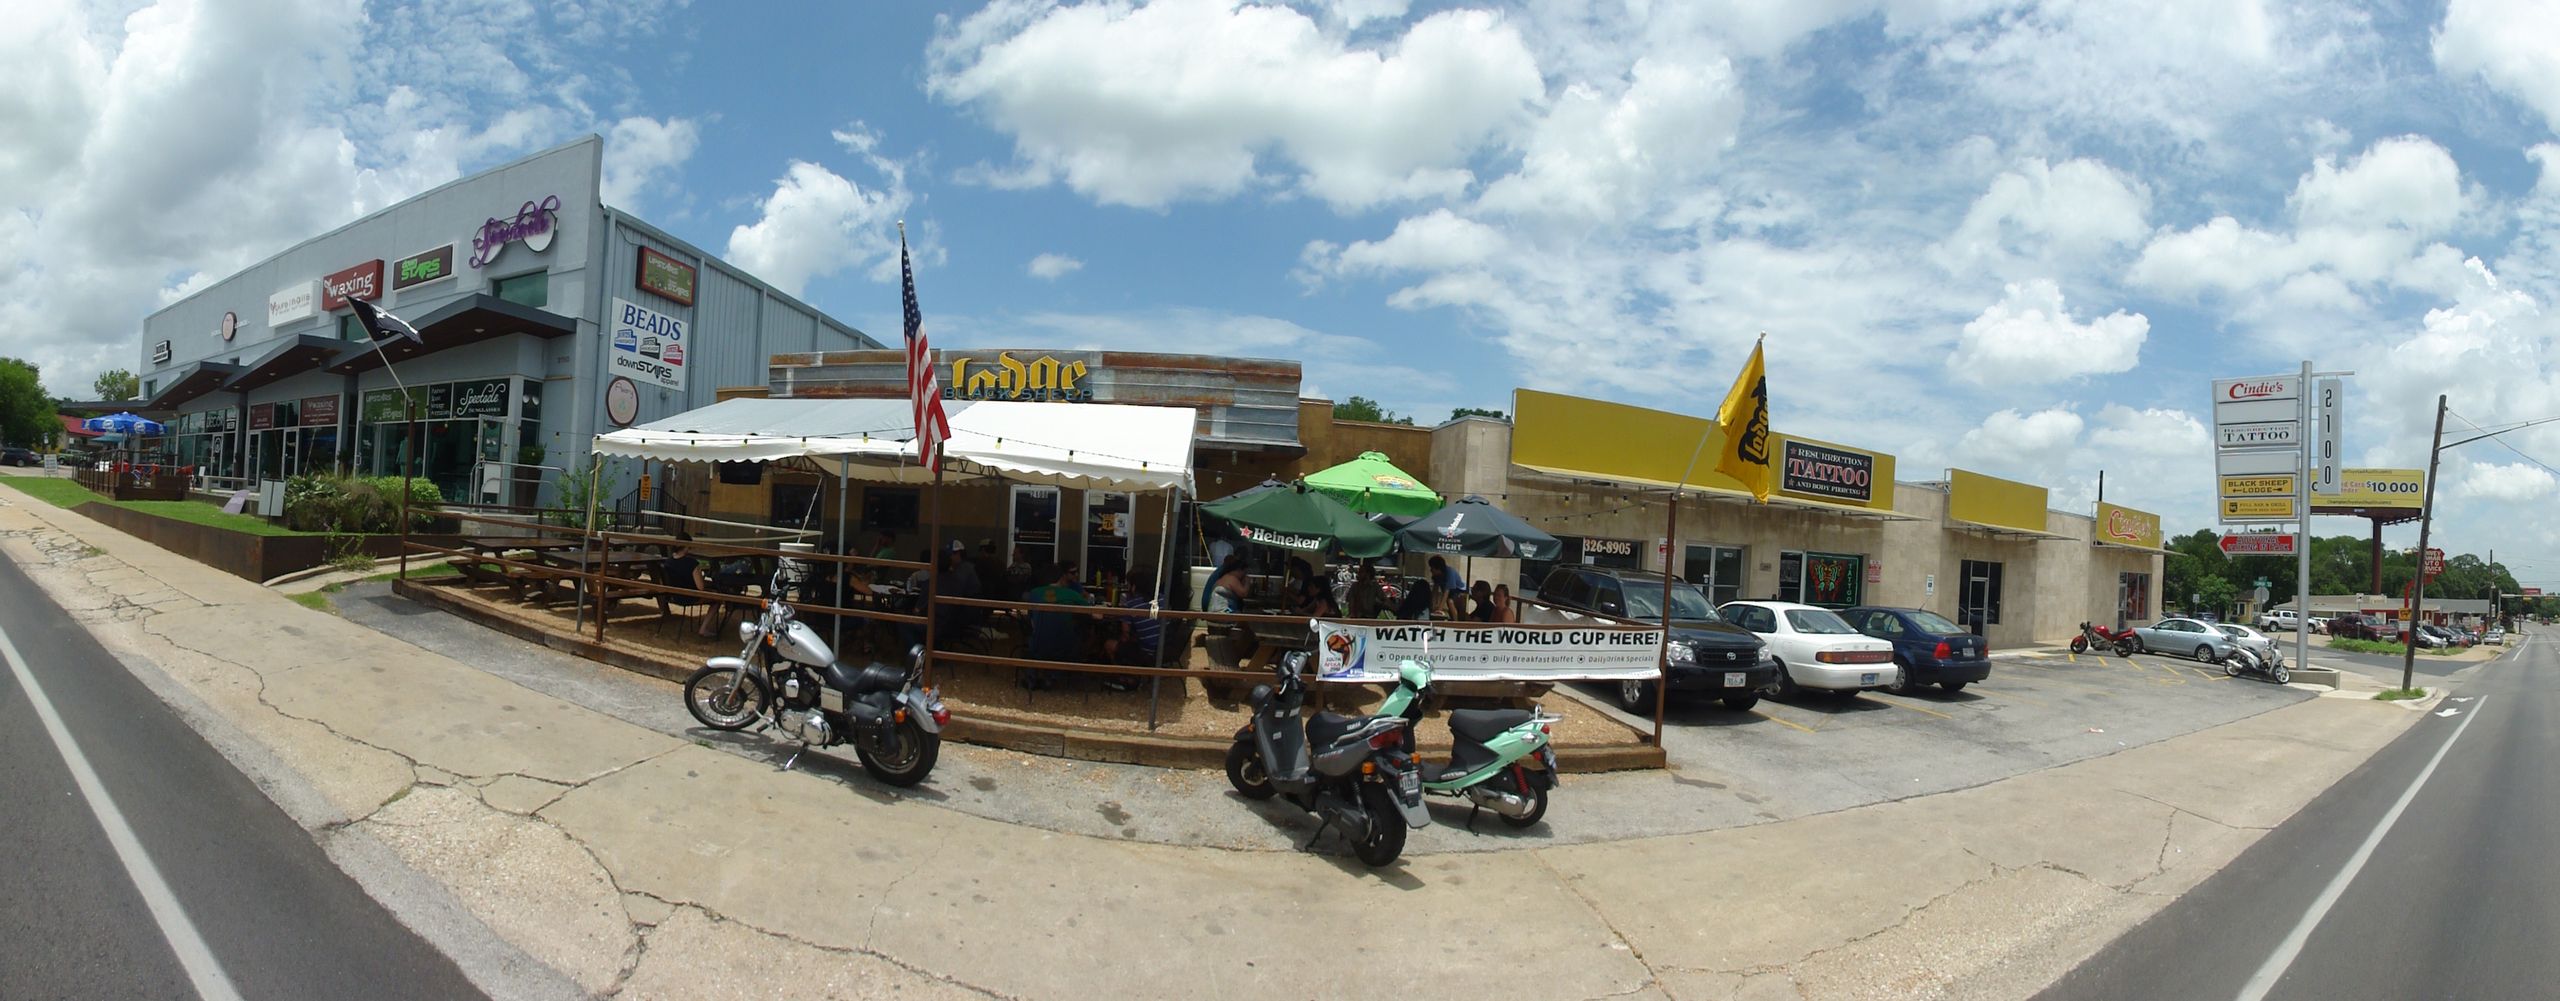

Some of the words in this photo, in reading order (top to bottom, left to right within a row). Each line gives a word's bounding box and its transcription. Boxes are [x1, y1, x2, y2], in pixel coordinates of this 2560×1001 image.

[324, 271, 374, 297] waxing
[622, 304, 682, 341] BEADS
[943, 386, 1011, 400] BLACK
[1020, 387, 1093, 401] SHEEP
[2229, 382, 2284, 400] Cindie's
[2224, 431, 2289, 442] TATTOO
[2324, 388, 2333, 485] 2100
[1798, 448, 1863, 466] RESURRECTION
[1788, 457, 1869, 487] TATTOO
[1812, 483, 1829, 491] BODY
[2258, 479, 2289, 487] SHEEP
[1252, 527, 1320, 550] Heineken
[1437, 542, 1462, 551] LIGHT
[1583, 538, 1631, 556] 326-8905
[1375, 627, 1446, 642] WATCH
[1453, 630, 1492, 644] THE
[1498, 630, 1563, 645] WORLD
[1569, 631, 1605, 645] CUP
[1609, 632, 1659, 645] HERE!
[1388, 652, 1412, 661] Open
[1448, 654, 1476, 662] Games
[1512, 655, 1550, 663] Breakfast
[1626, 655, 1654, 663] Specials
